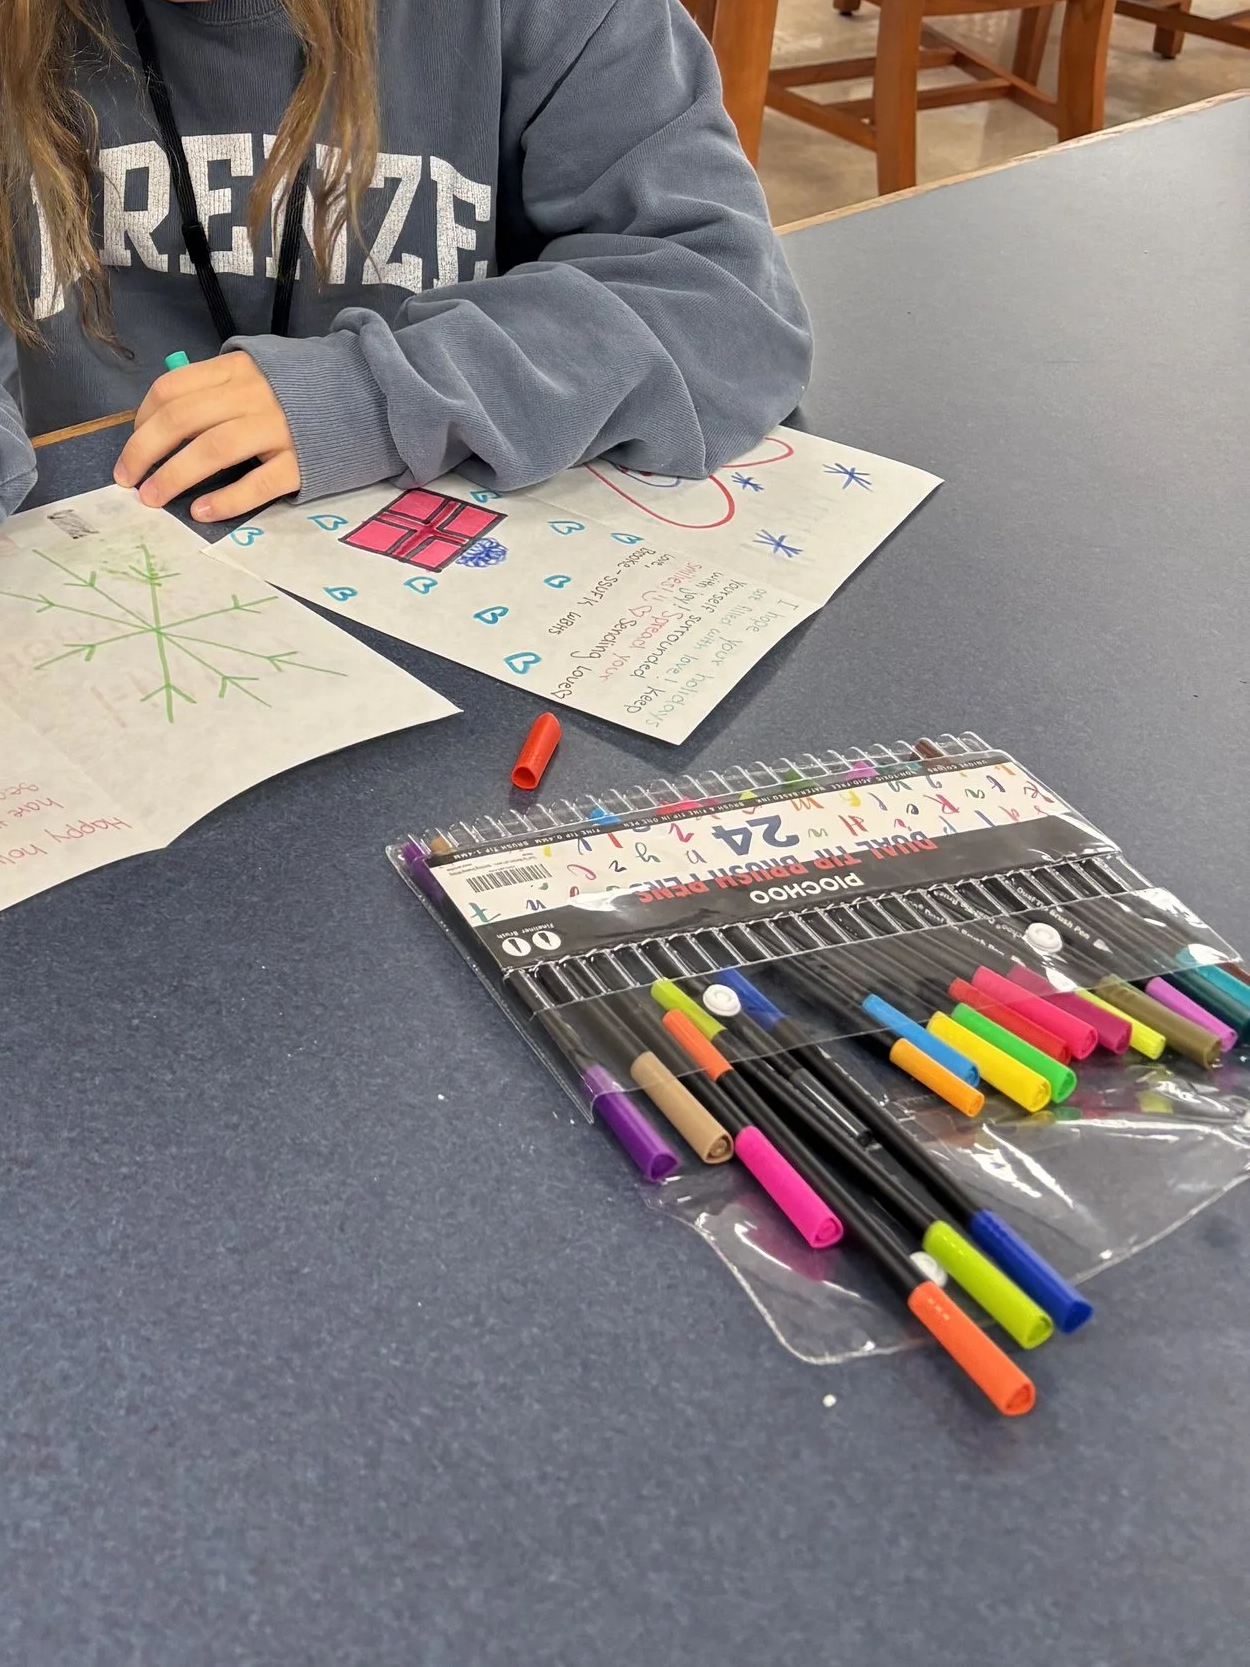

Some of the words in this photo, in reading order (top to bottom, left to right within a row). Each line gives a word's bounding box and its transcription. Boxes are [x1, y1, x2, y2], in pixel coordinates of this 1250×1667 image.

[745, 611, 781, 630] hope
[570, 616, 637, 659] Sending
[629, 615, 700, 682] surrounded
[712, 637, 741, 665] your
[598, 652, 630, 681] your
[646, 673, 714, 730] holidays
[44, 816, 131, 844] Happy
[500, 840, 528, 850] BRUSH
[711, 814, 801, 856] 24
[856, 830, 939, 861] DUAL
[708, 854, 809, 890] BRUSH
[814, 844, 862, 870] TIP
[630, 872, 711, 903] PENS
[749, 872, 865, 905] PIOCHOO
